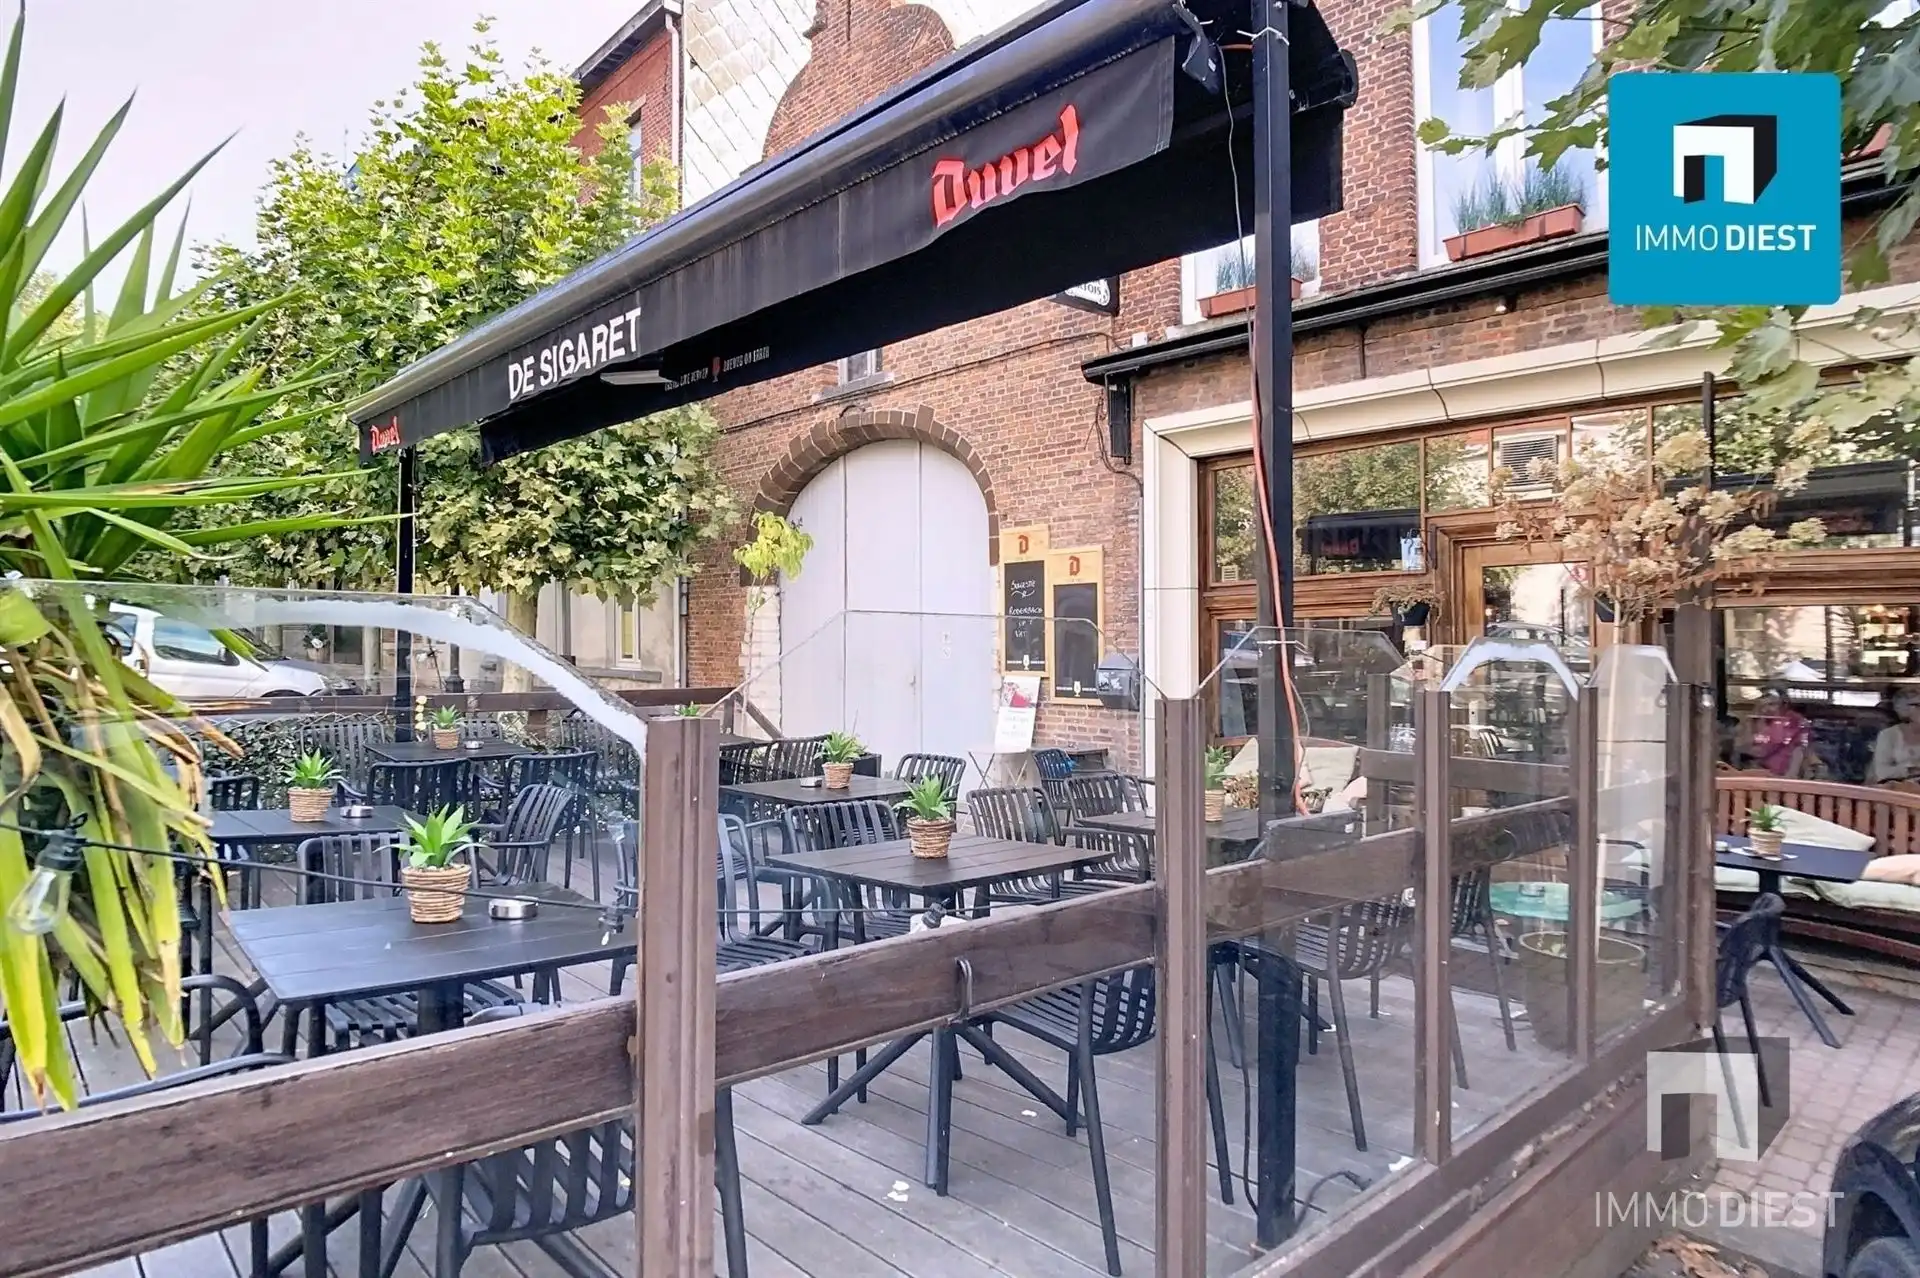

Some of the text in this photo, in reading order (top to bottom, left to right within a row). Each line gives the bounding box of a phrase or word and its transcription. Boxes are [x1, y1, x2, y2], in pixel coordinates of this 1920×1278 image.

[932, 104, 1080, 228] Duvel
[508, 307, 642, 400] DE SIGARET
[369, 415, 401, 456] Duvel
[1018, 534, 1029, 555] D
[1069, 555, 1080, 576] D
